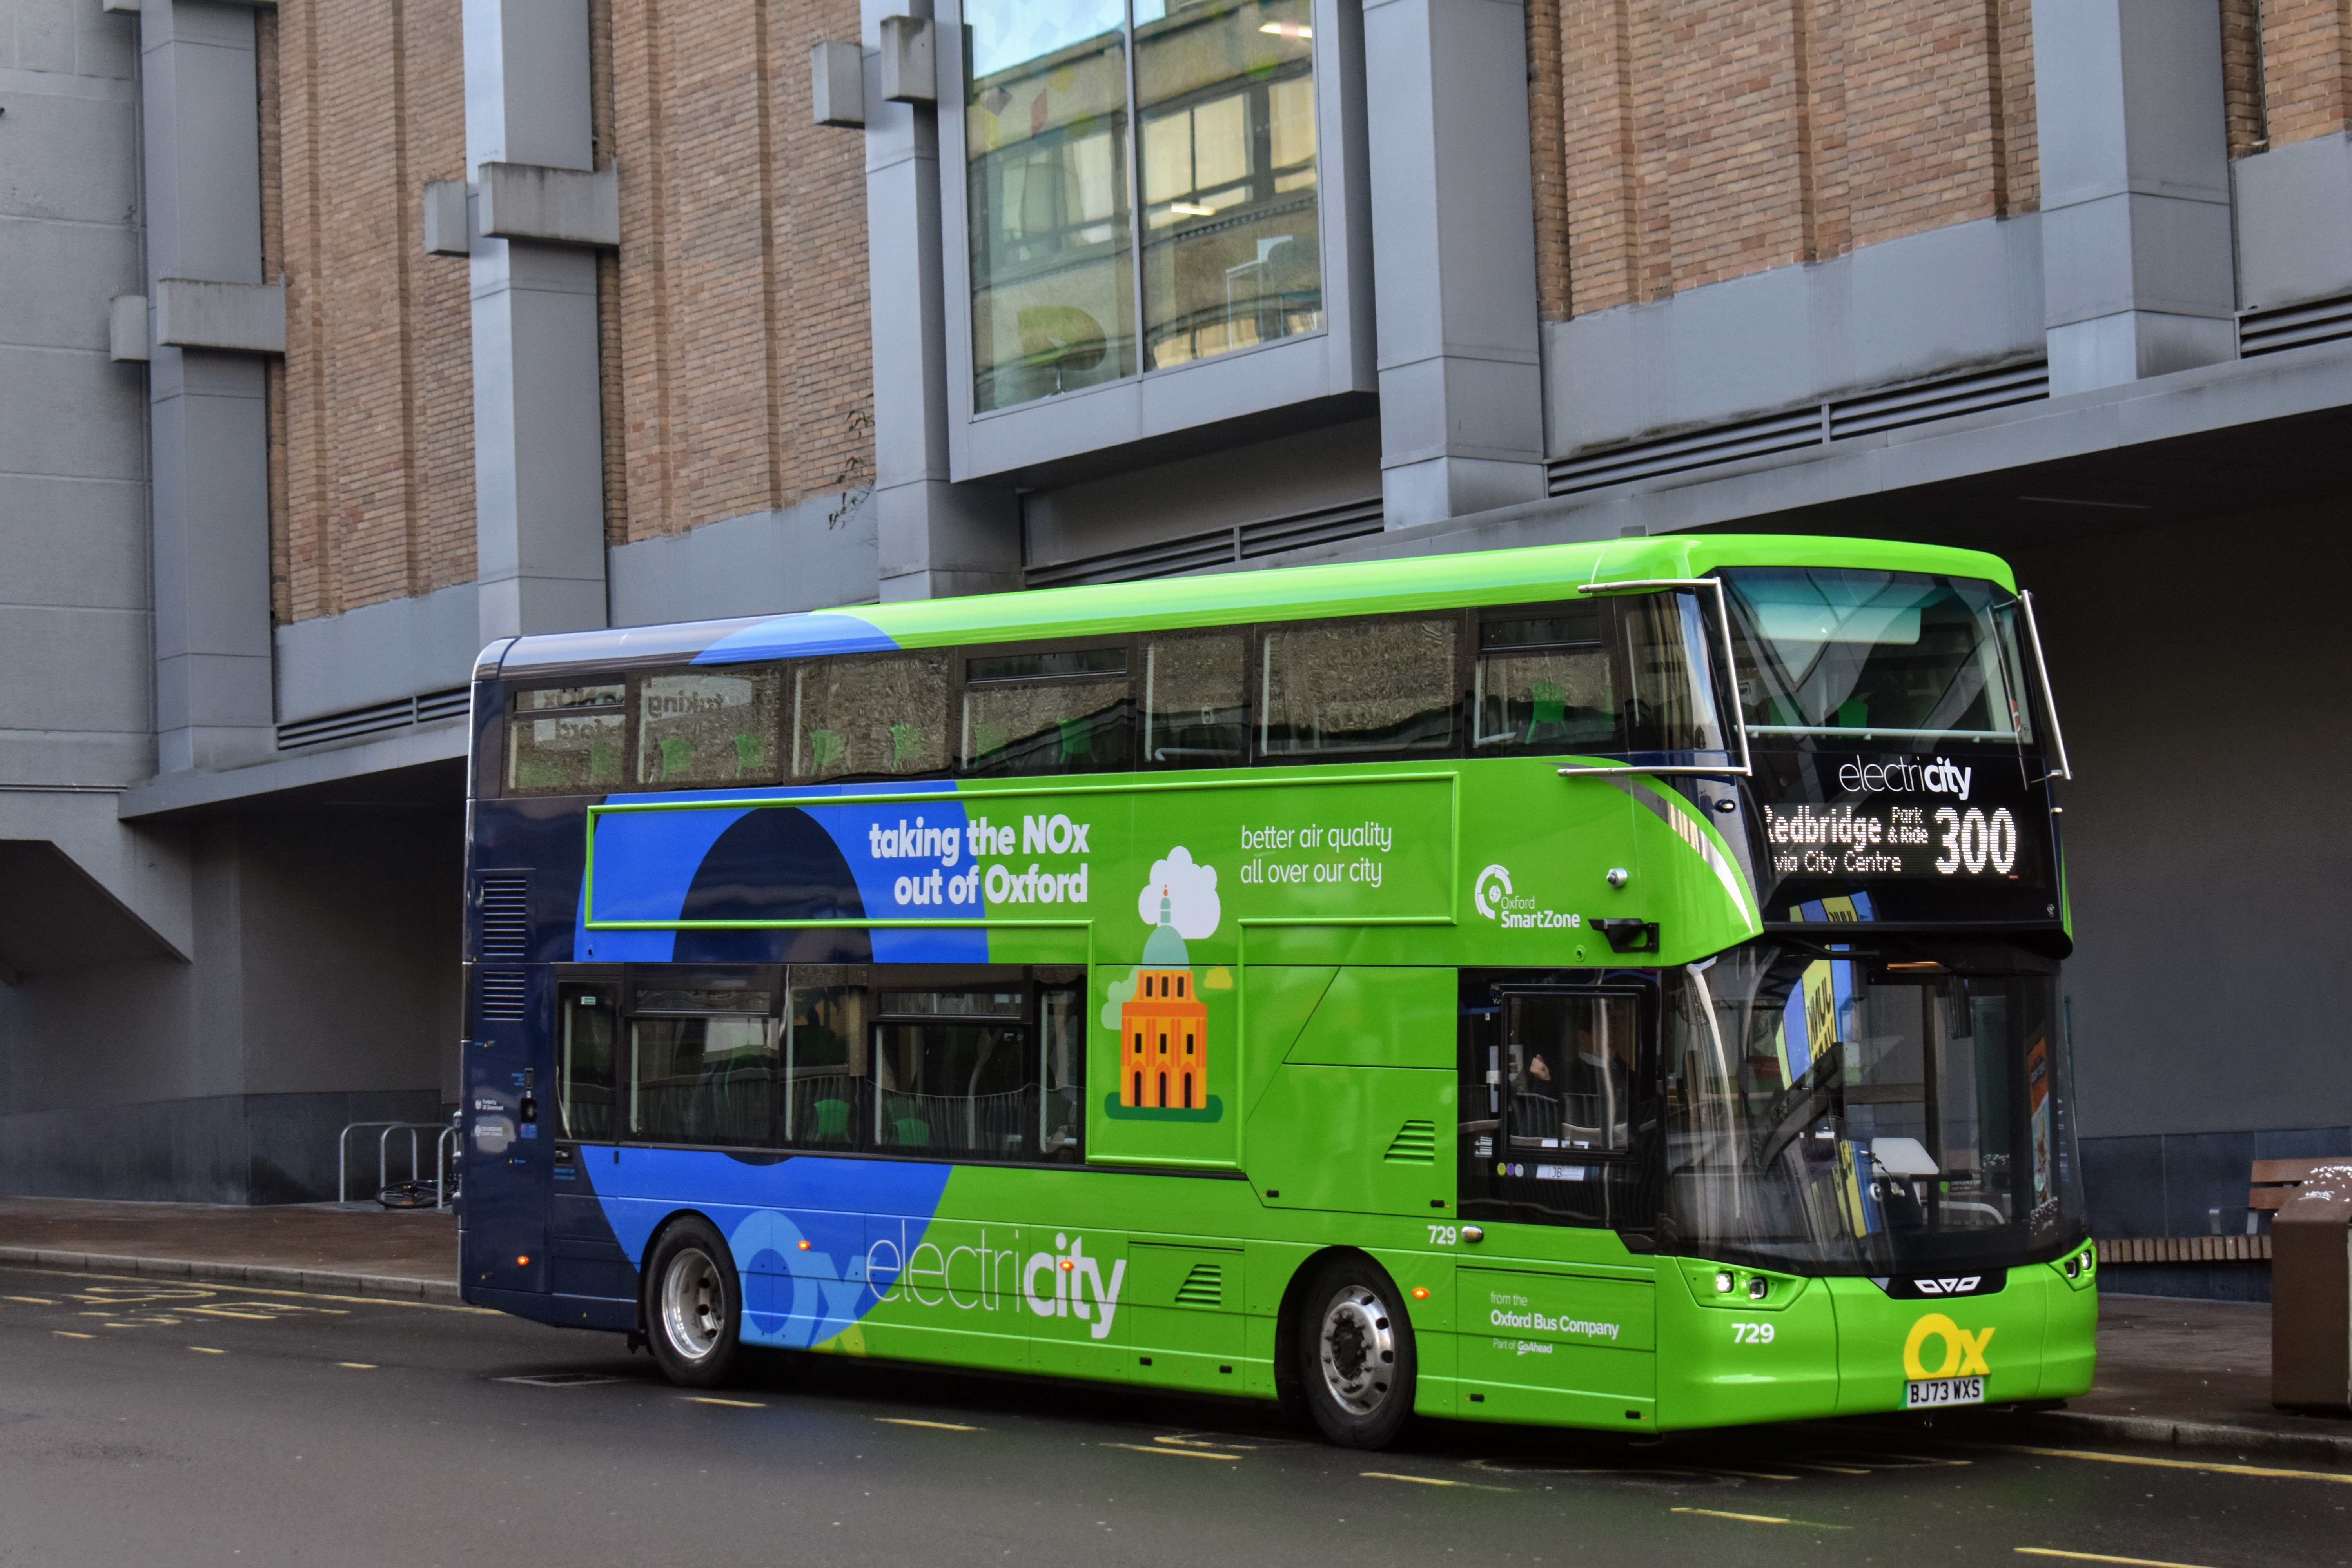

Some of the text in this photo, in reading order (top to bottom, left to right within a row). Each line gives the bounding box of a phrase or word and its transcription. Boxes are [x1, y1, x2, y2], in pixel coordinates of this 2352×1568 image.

[1839, 754, 1971, 800] electricity
[1892, 806, 1923, 824] Park
[869, 814, 1090, 867] taking the NOx
[1241, 821, 1392, 852] better air quality
[1887, 826, 1929, 843] & Ride
[1933, 807, 2016, 874] 300
[1241, 858, 1382, 887] all over our city
[1774, 850, 1902, 874] via City Centre
[895, 863, 1088, 904] out of Oxford
[1501, 896, 1535, 910] Oxford
[1501, 910, 1581, 929] SmartZone
[1428, 1225, 1457, 1245] 729
[867, 1218, 1127, 1339] electricity
[1491, 1291, 1528, 1307] from the
[1491, 1309, 1620, 1341] Oxford Bus Company
[1731, 1323, 1775, 1344] 729
[1493, 1338, 1553, 1354] Part of GoAhead
[1903, 1313, 1996, 1380] Ox
[1910, 1379, 1980, 1404] BJ73 WXS
